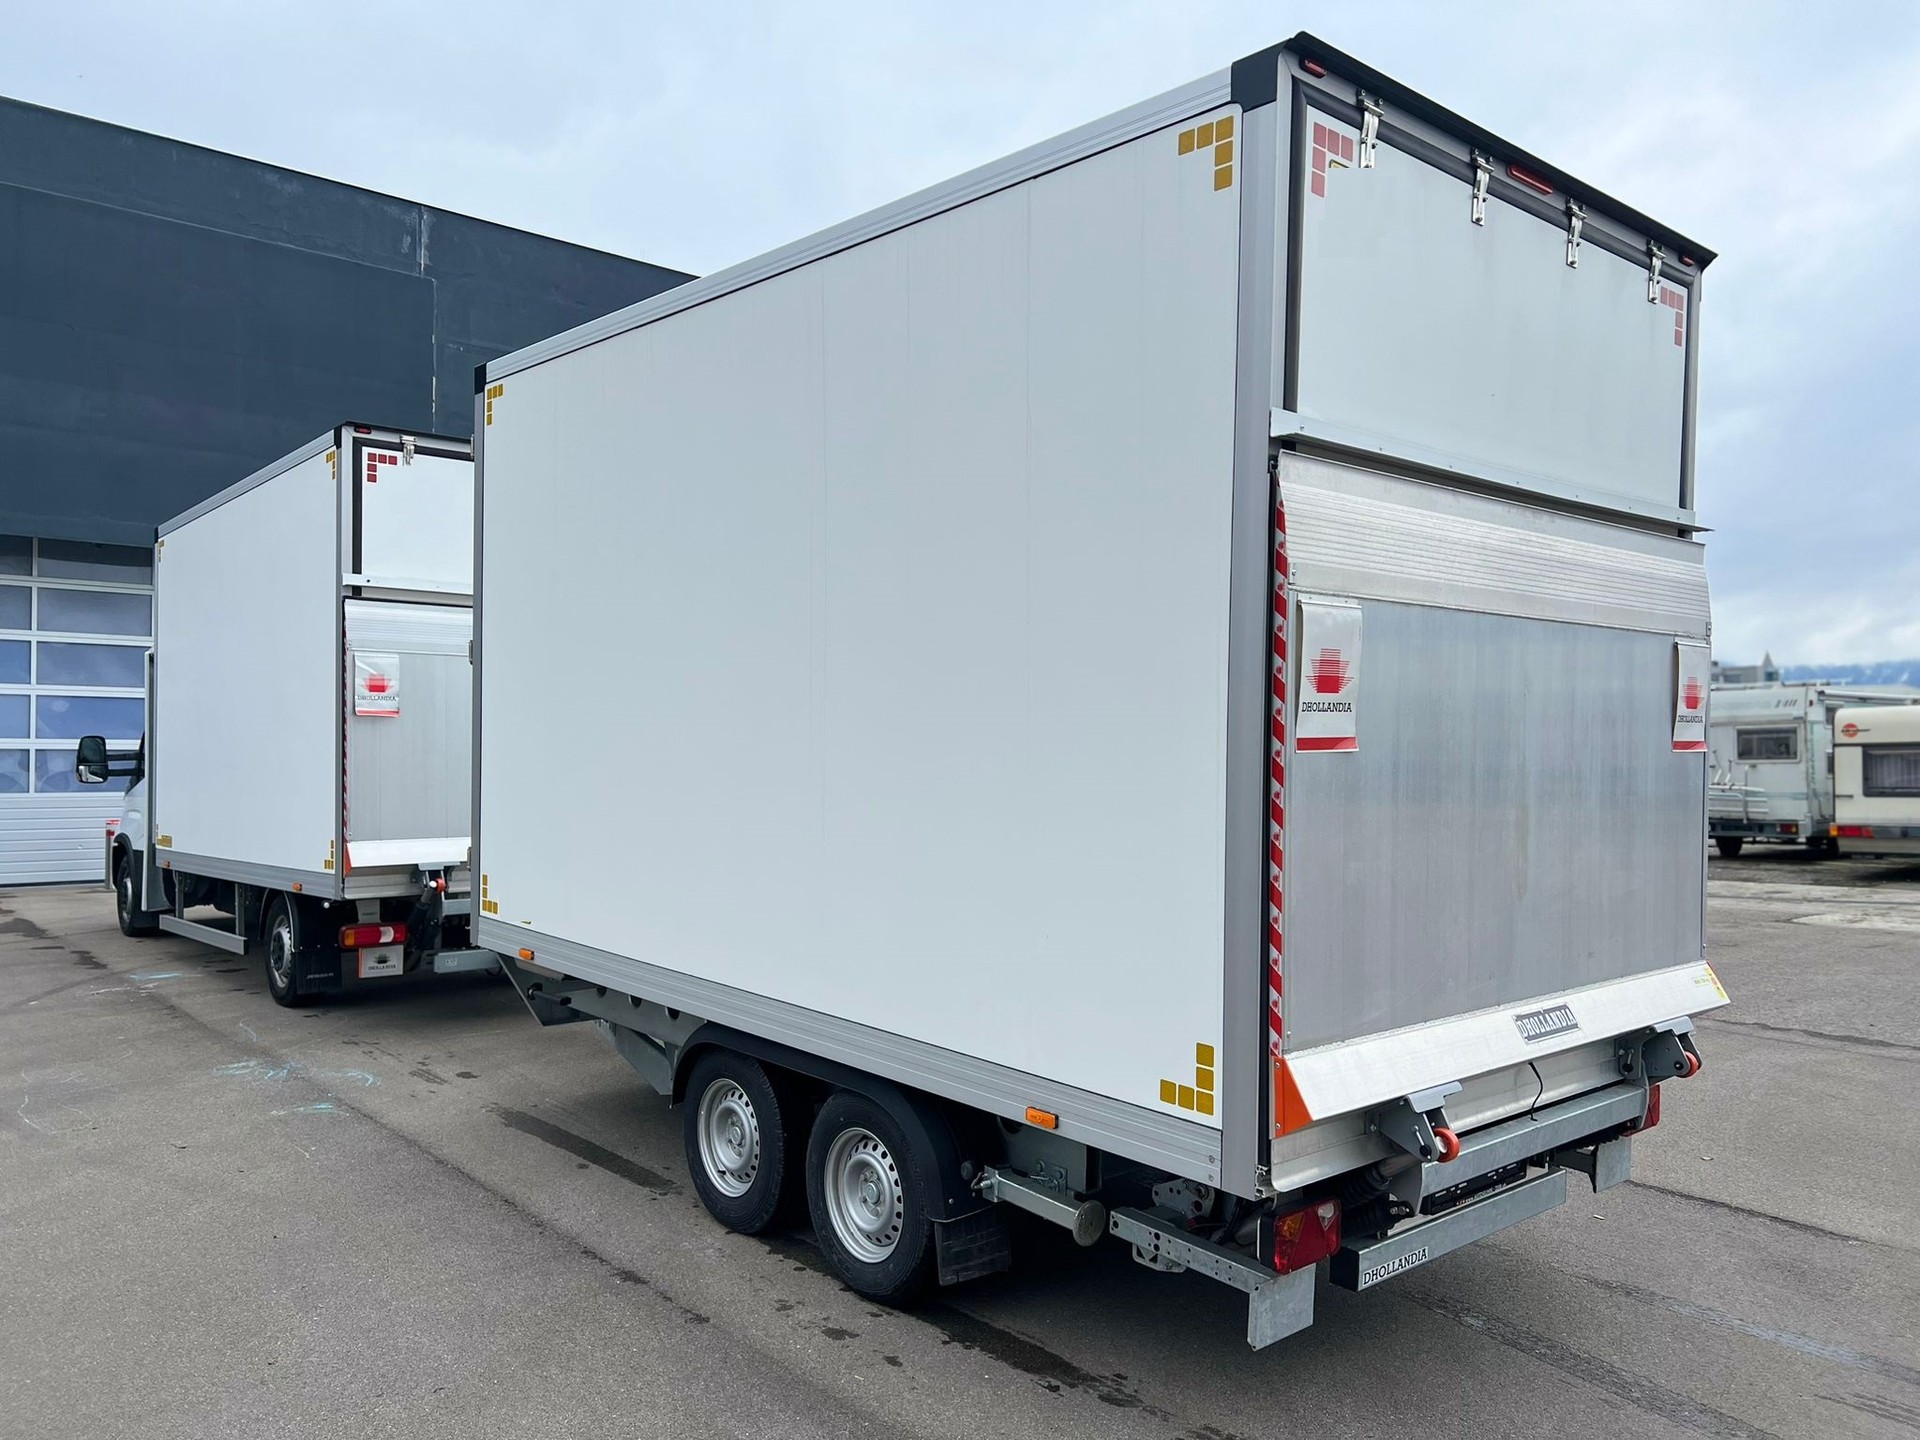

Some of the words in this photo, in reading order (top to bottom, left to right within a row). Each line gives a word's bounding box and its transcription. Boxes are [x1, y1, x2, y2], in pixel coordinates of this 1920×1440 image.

[1301, 702, 1352, 713] DHOLLANDIA
[1516, 1008, 1577, 1037] DHOLLANDIA
[1363, 1248, 1427, 1285] DHOLLANDIA
